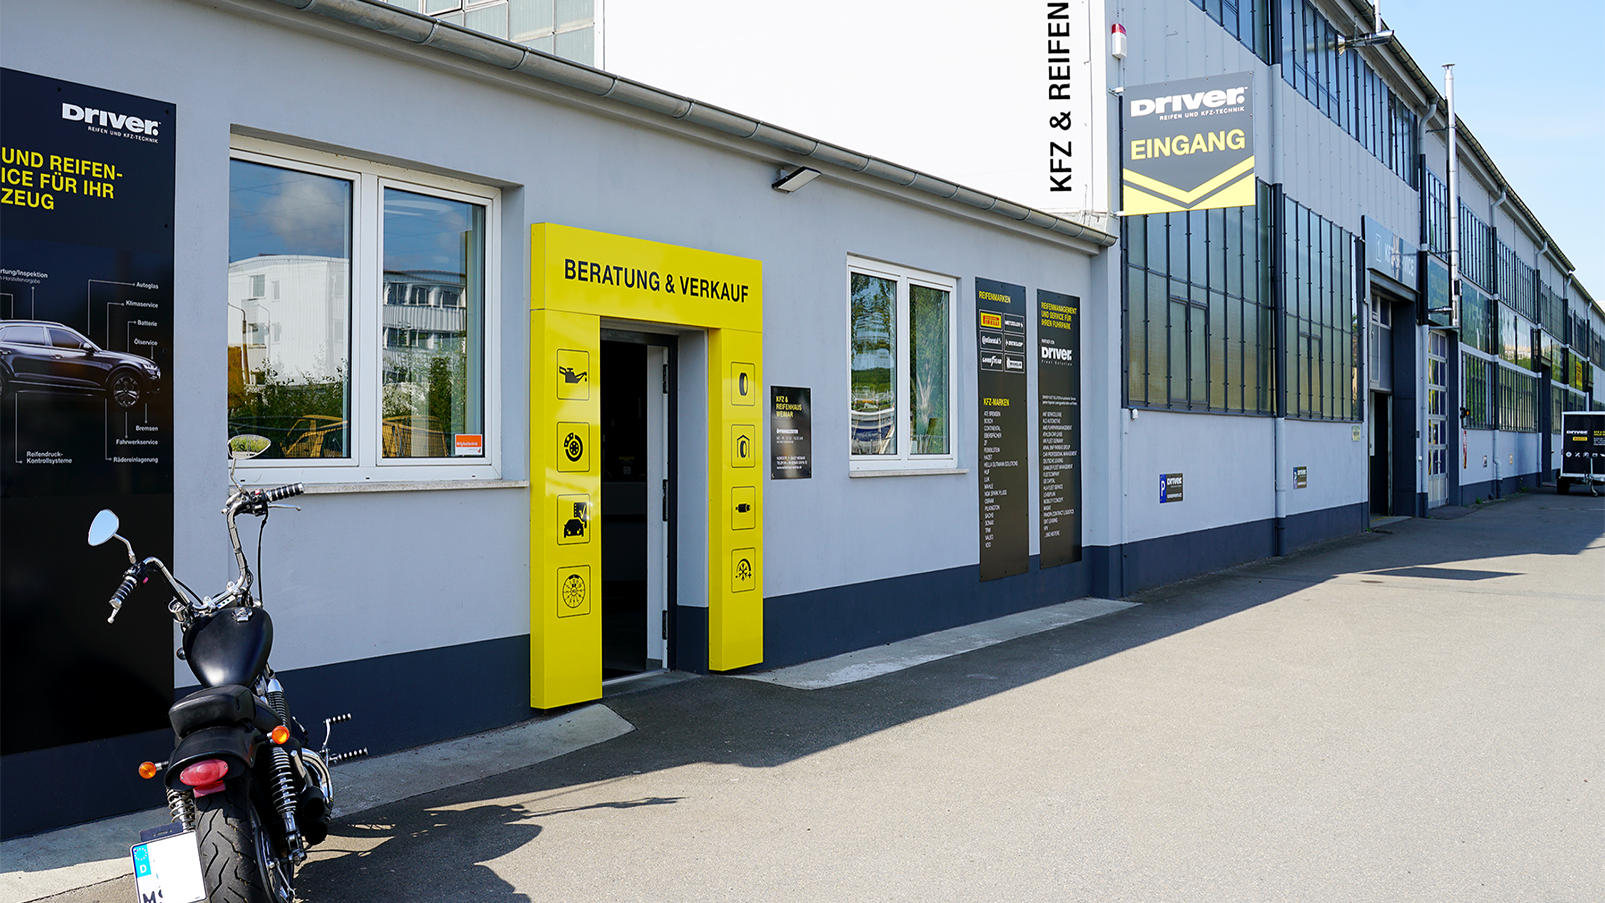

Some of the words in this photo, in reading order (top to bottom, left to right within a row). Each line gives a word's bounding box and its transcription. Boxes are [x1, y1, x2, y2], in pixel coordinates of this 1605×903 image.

[1047, 2, 1070, 100] REIFEN
[1050, 111, 1072, 130] &
[1159, 112, 1182, 121] REIFEN
[1200, 106, 1245, 117] KFZ-TECHNIK
[88, 125, 108, 134] REIFEN
[123, 132, 159, 144] KFZ-TECHNIK
[1131, 128, 1246, 160] EINGANG
[1, 146, 44, 168] UND
[50, 154, 123, 180] REIFEN-
[1050, 141, 1072, 192] KFZ
[40, 170, 77, 194] FÜR
[83, 179, 115, 200] IHR
[1, 187, 54, 210] ZEUG
[136, 282, 159, 290] Autoglas
[564, 258, 661, 292] BERATUNG
[665, 274, 676, 294] &
[679, 275, 749, 303] VERKAUF
[125, 300, 159, 309] Klimaservice
[979, 290, 1011, 304] REIFENMARKEN
[134, 338, 158, 346] Ölservice
[776, 403, 802, 411] REIFENHAUS
[984, 398, 1010, 406] KFZ-MARKEN
[113, 456, 159, 464] Rädereinlagerung
[1161, 480, 1166, 496] P
[140, 864, 147, 874] D
